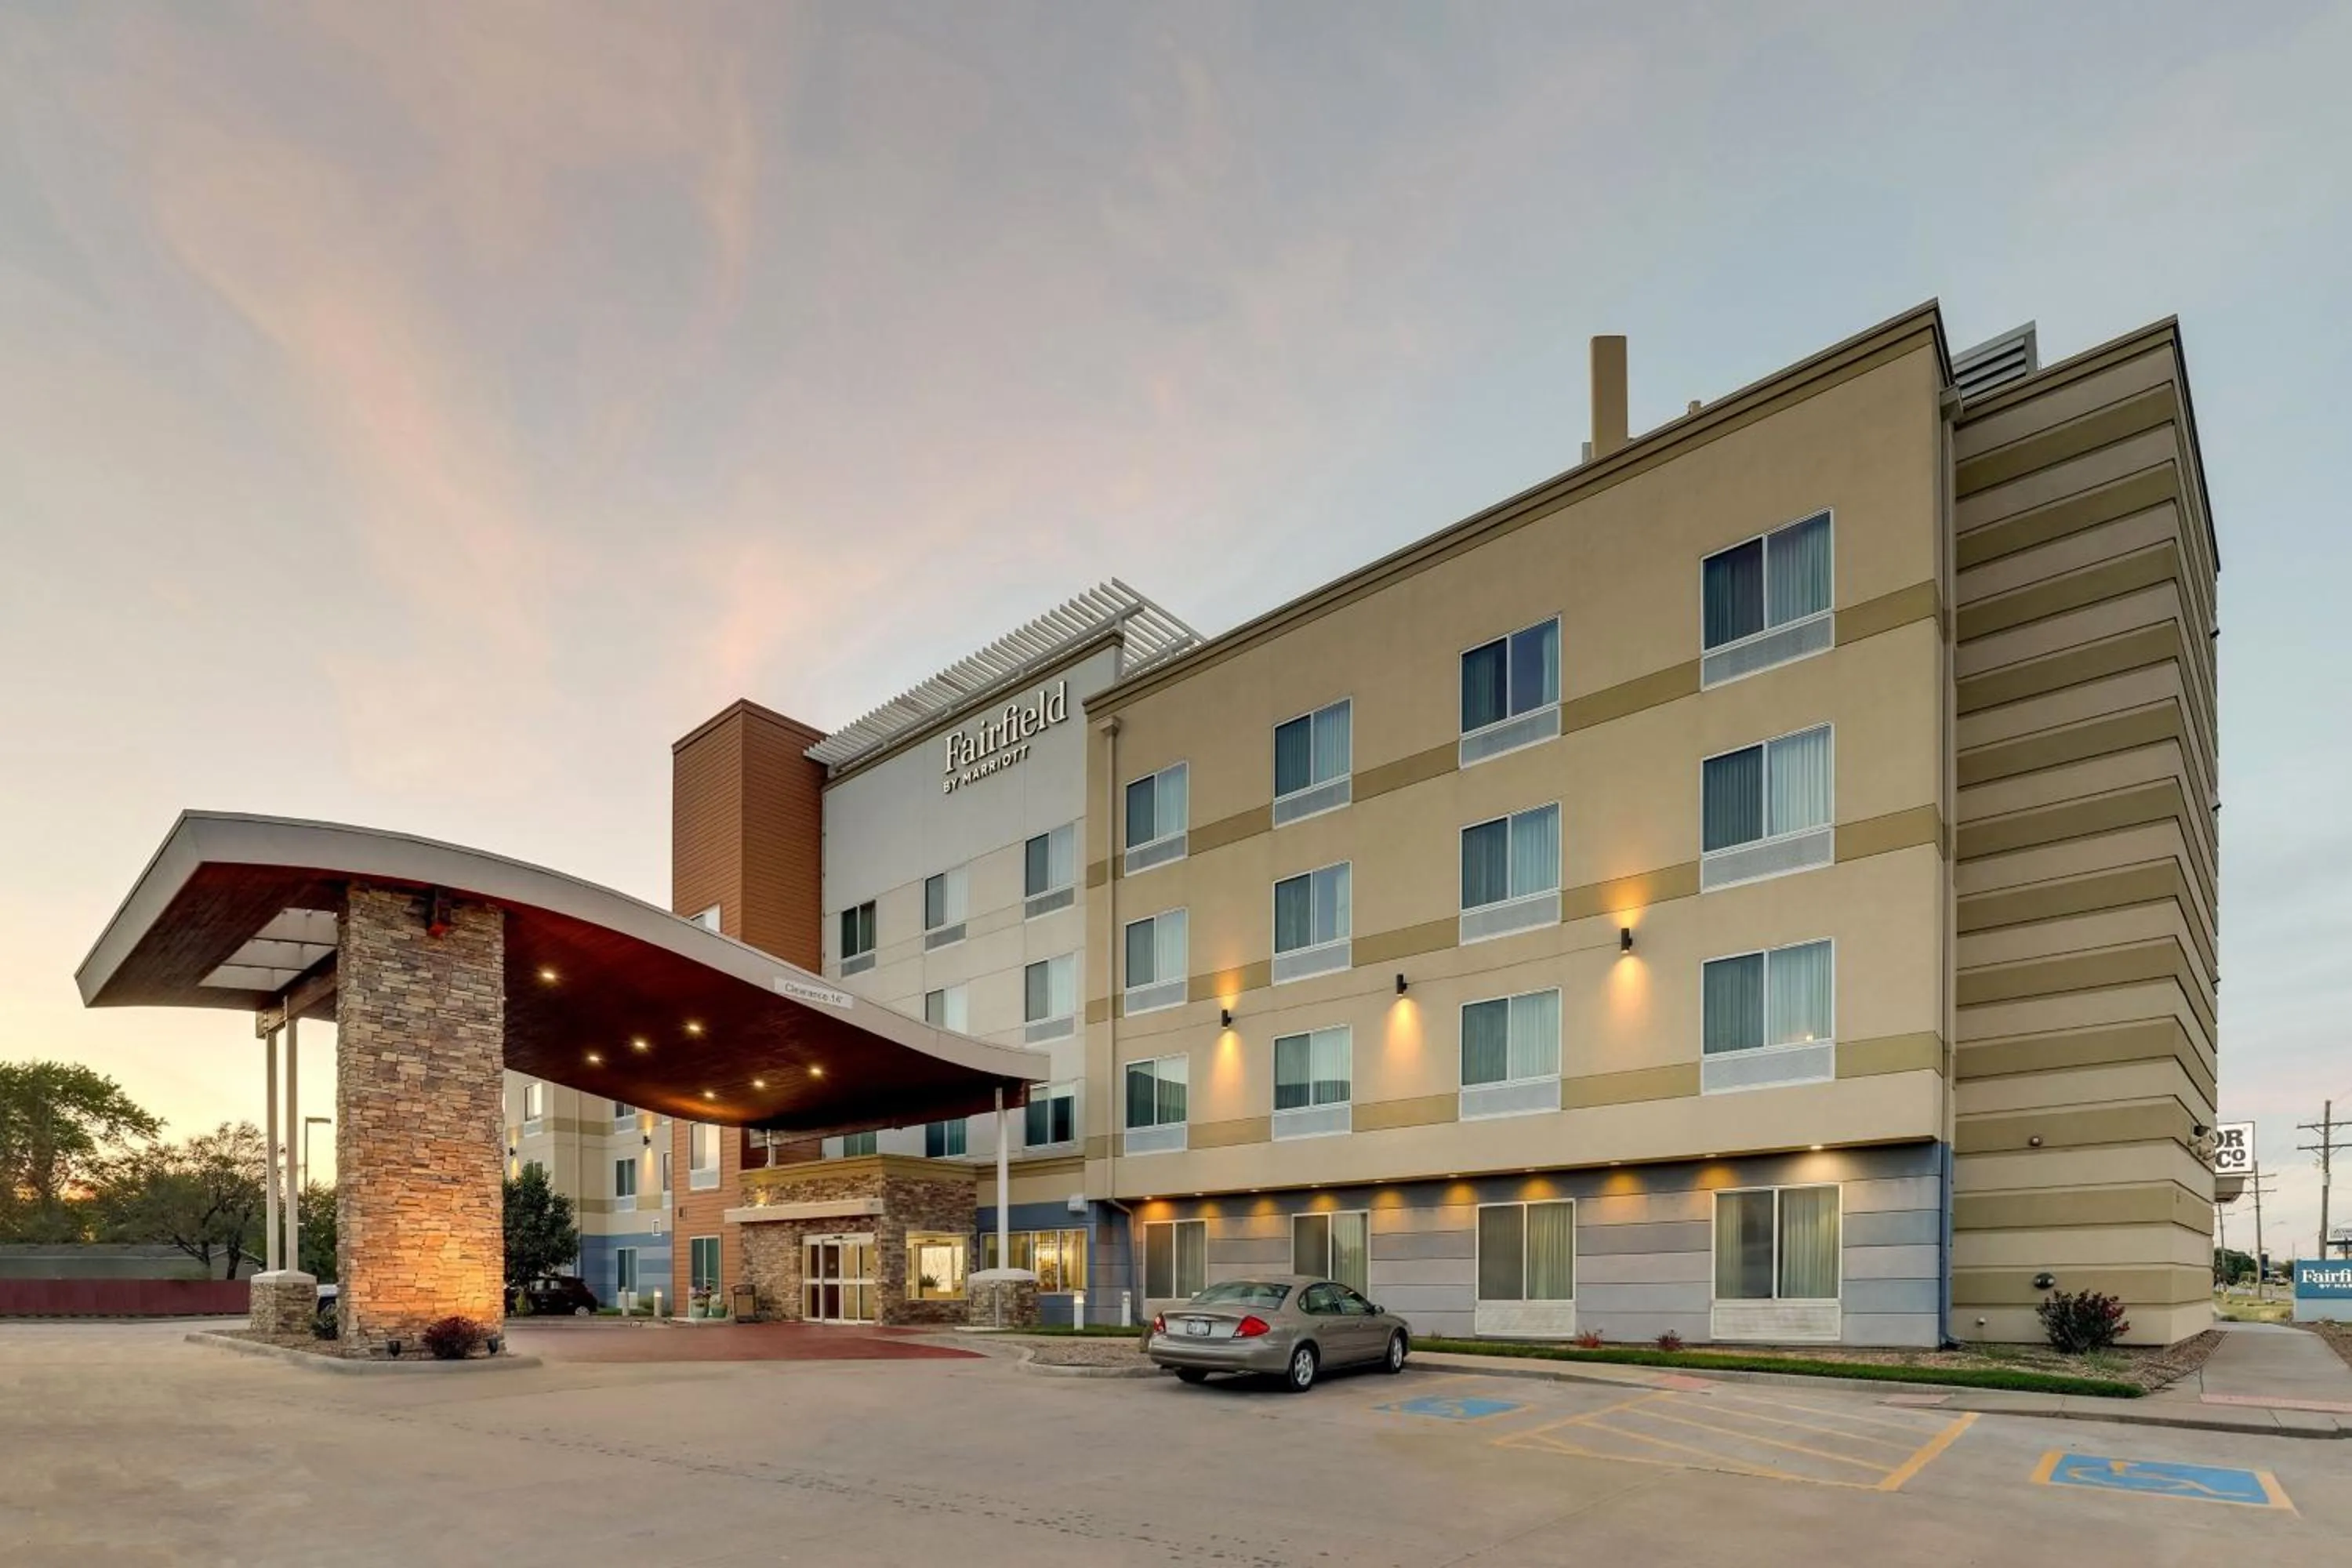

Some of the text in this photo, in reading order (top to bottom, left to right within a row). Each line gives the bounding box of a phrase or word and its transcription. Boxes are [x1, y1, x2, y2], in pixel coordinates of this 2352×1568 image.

[945, 680, 1068, 775] Fairfield
[942, 745, 1030, 794] BY MARRIOTT
